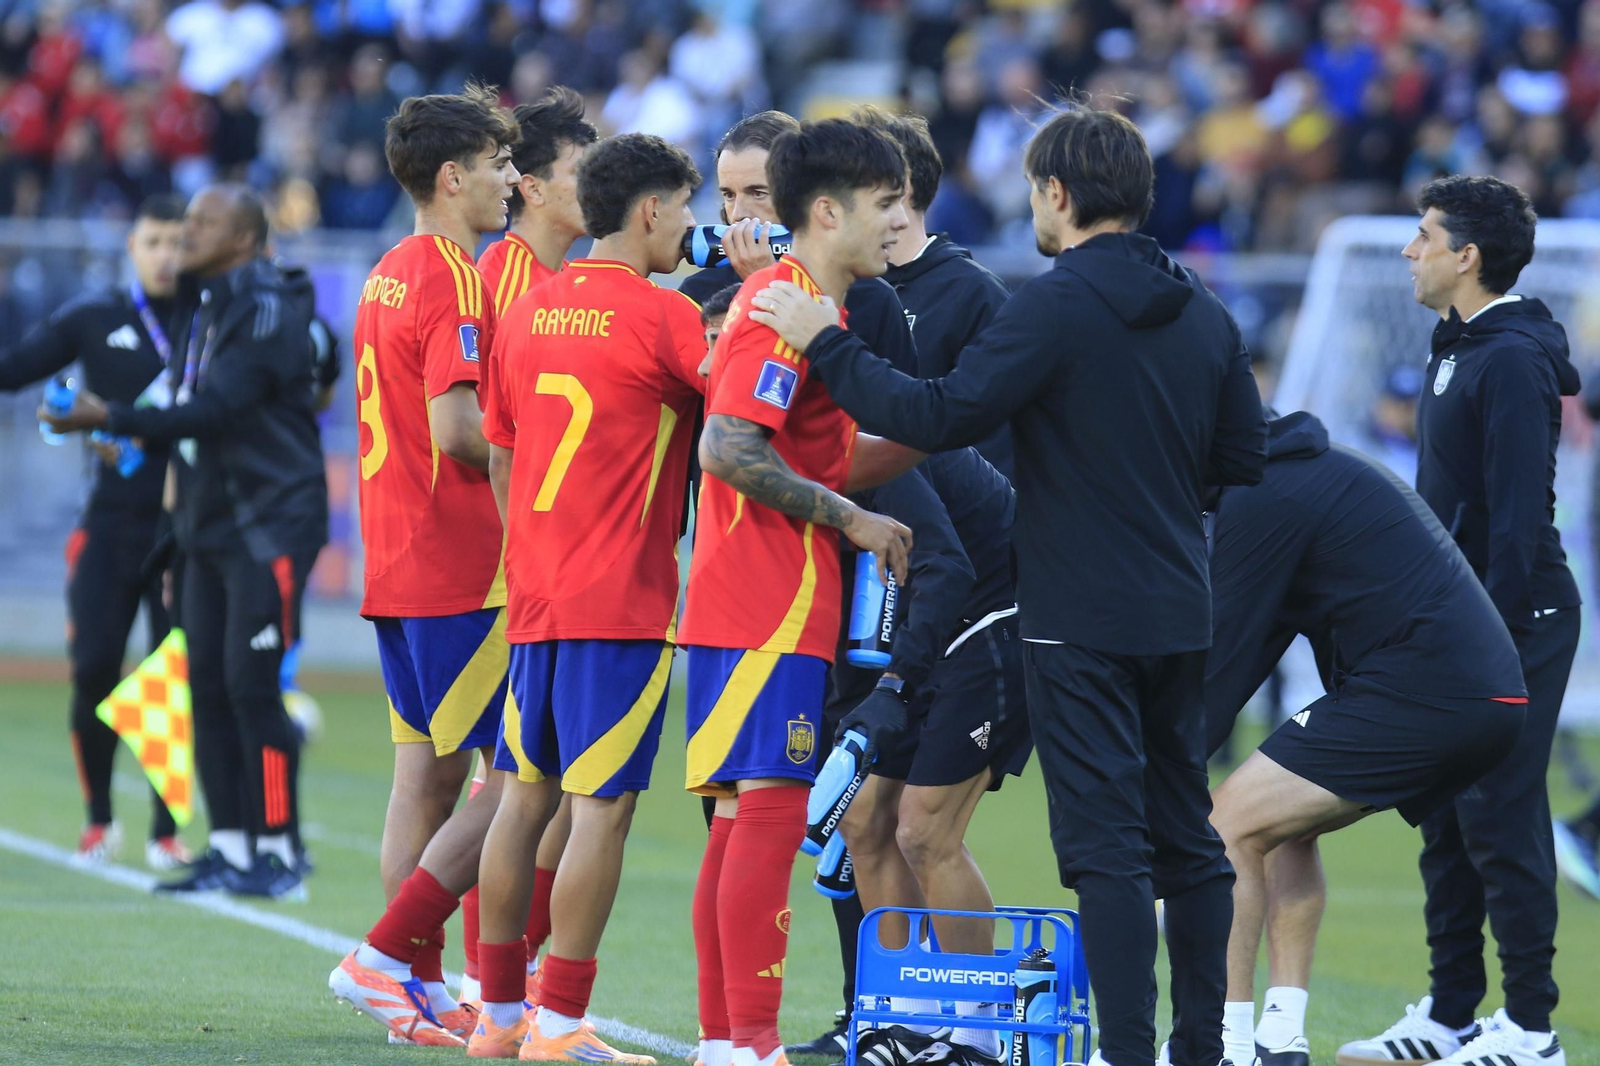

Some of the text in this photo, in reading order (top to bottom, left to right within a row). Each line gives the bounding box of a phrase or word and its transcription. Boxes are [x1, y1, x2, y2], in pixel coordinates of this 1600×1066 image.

[531, 307, 615, 337] RAYANE
[532, 372, 593, 512] 7
[881, 570, 897, 643] POWERAD
[820, 771, 862, 837] POWERAD
